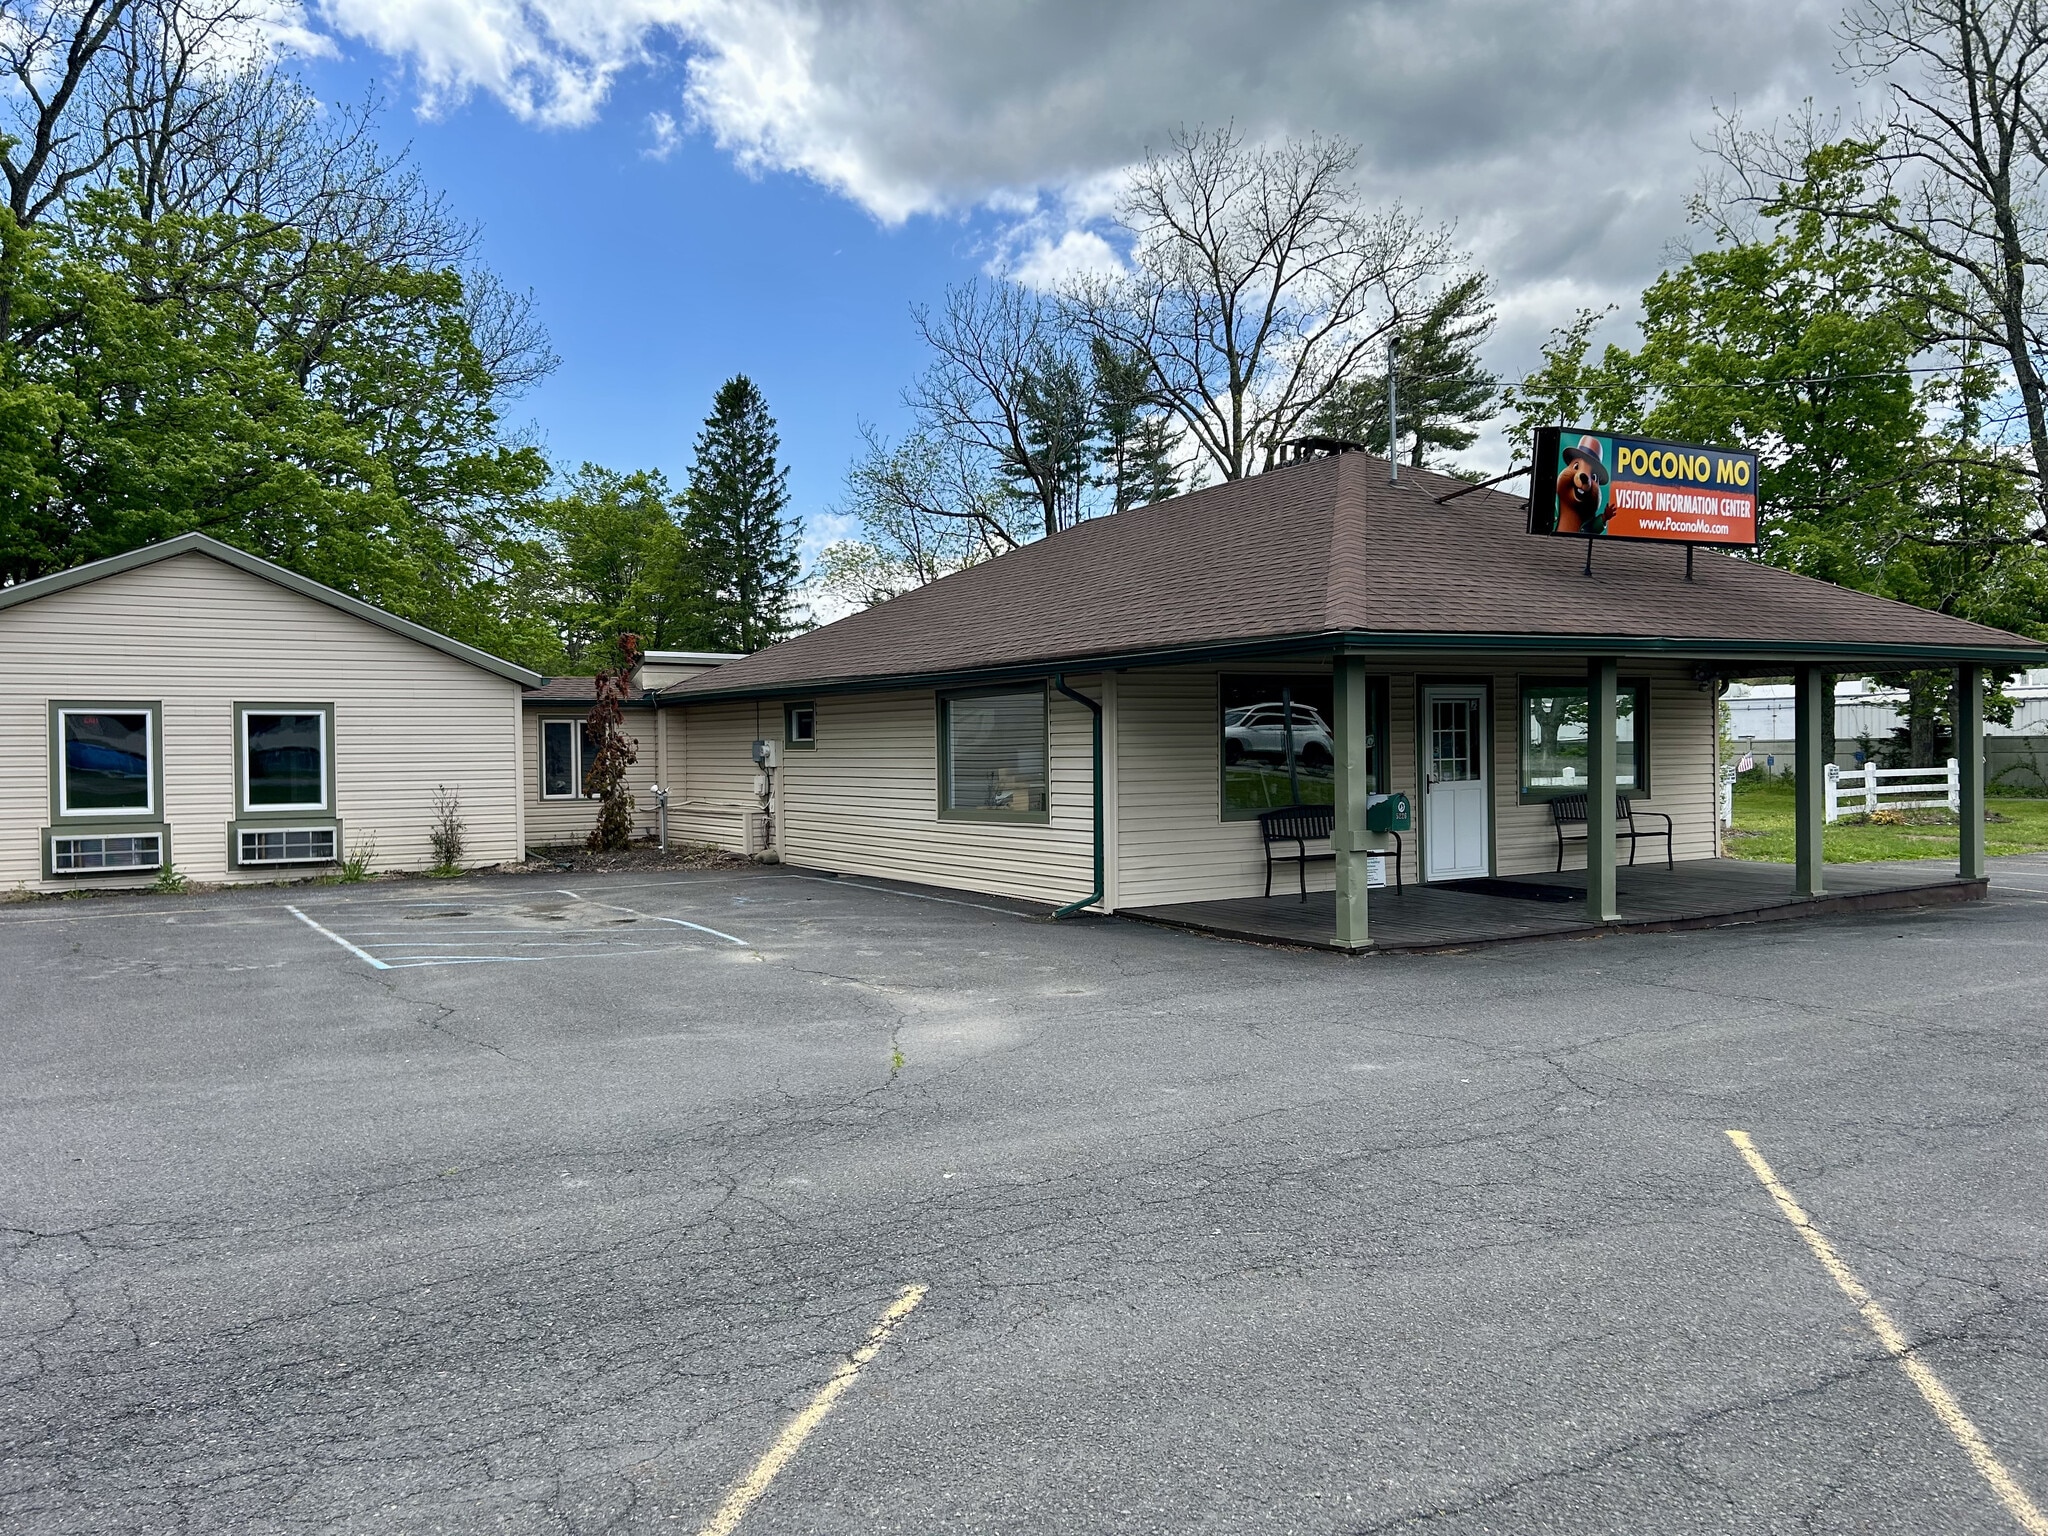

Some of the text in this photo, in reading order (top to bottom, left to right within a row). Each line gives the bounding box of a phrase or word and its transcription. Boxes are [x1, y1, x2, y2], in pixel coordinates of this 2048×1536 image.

[1618, 447, 1750, 486] POCONO MO
[1615, 489, 1751, 518] VISITOR INFORMATION CENTER
[1639, 517, 1729, 535] www.PoconoMo.com
